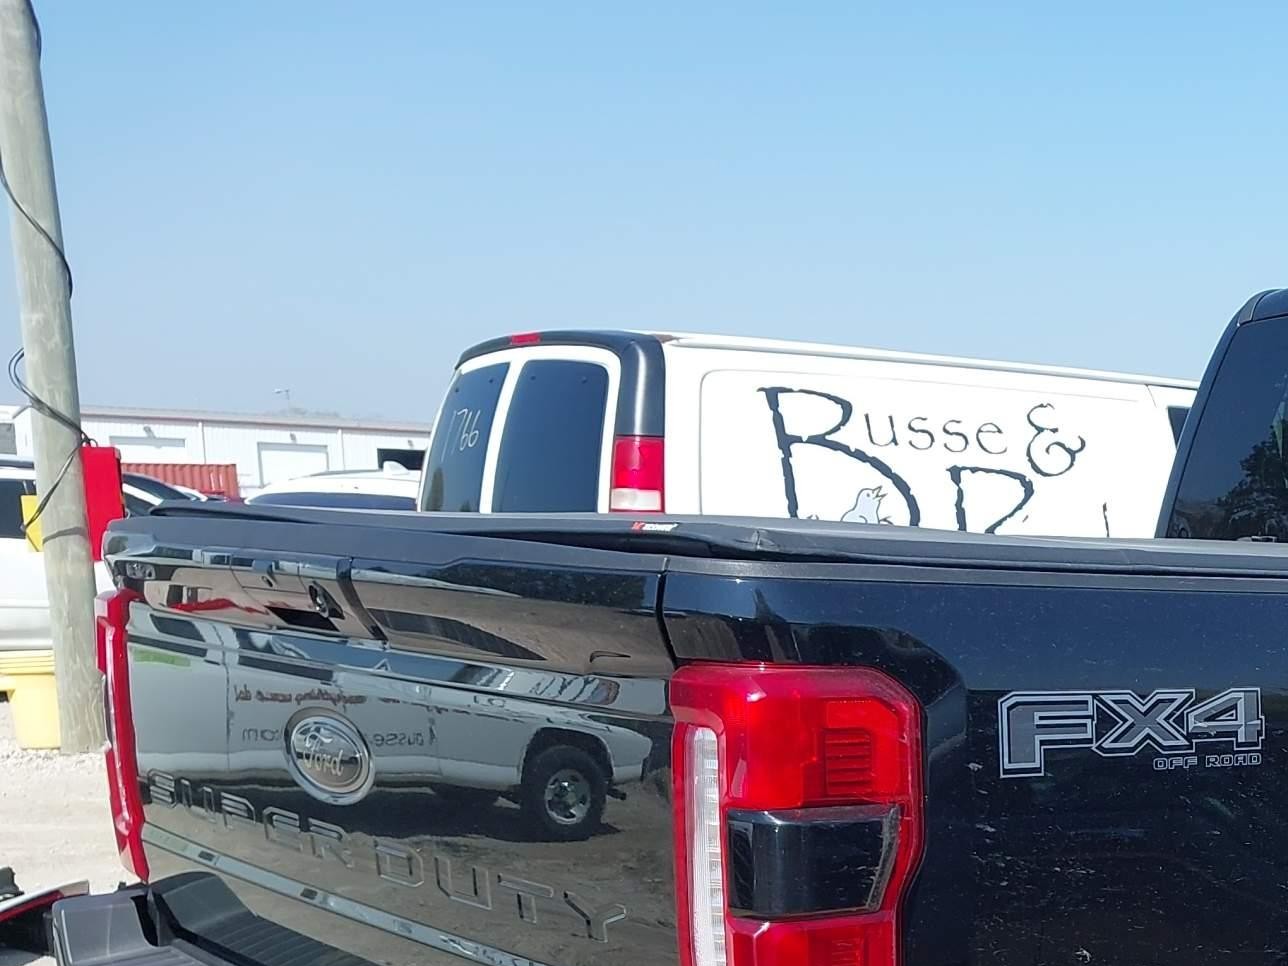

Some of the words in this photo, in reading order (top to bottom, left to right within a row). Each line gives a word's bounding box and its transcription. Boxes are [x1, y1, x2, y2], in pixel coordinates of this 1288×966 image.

[1026, 403, 1086, 477] &
[304, 726, 344, 777] Ford
[998, 688, 1265, 778] FX4
[1153, 756, 1198, 770] OFF
[1204, 753, 1262, 767] ROAD
[147, 768, 355, 868] SUPER
[374, 838, 627, 943] DUTY
